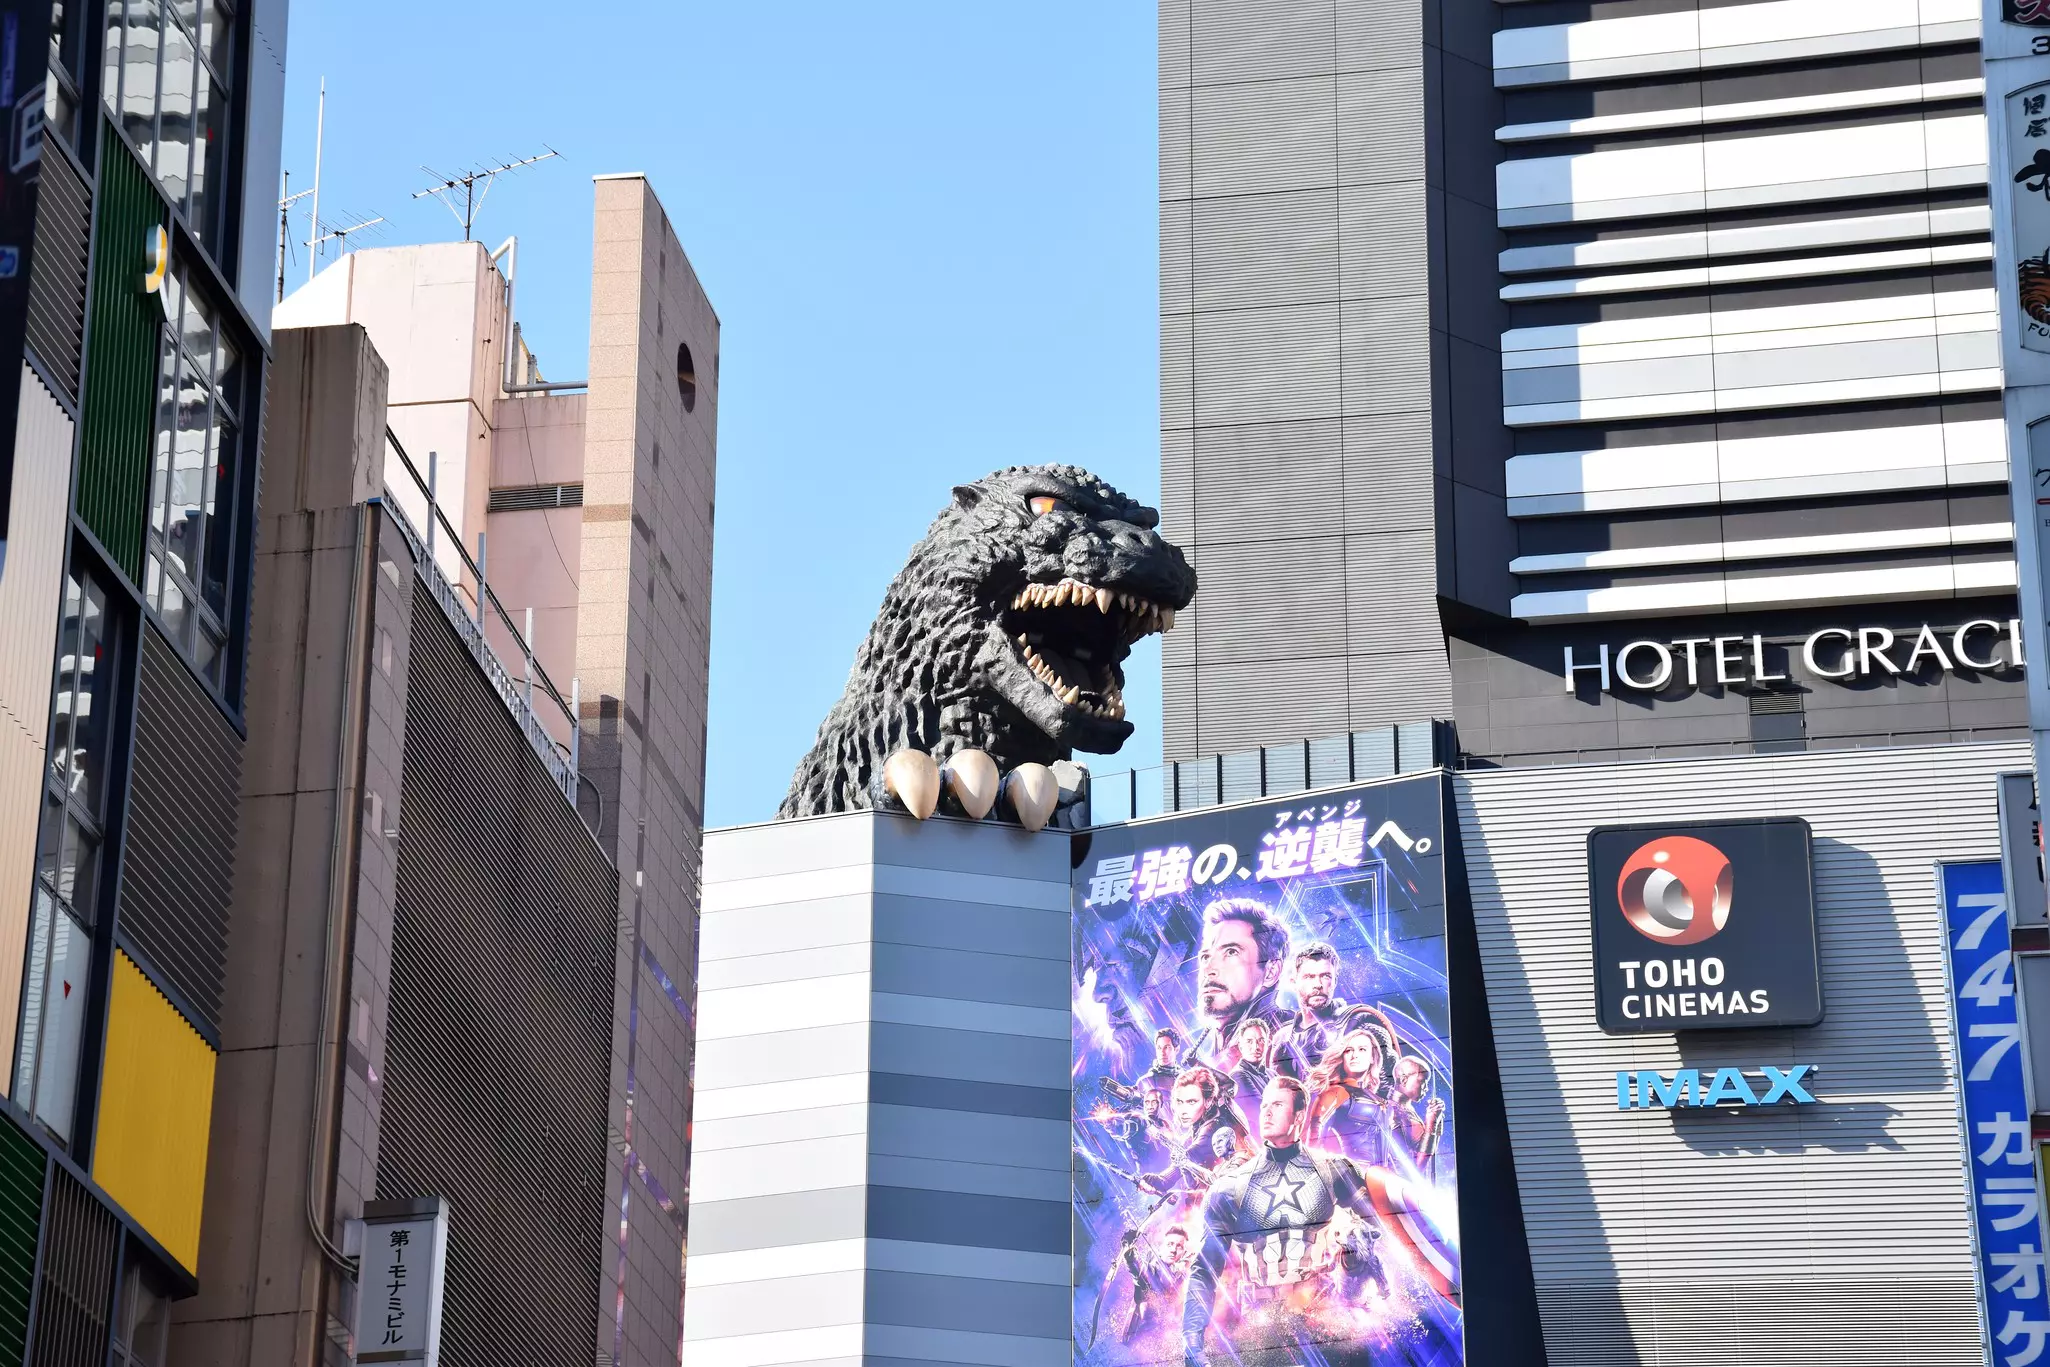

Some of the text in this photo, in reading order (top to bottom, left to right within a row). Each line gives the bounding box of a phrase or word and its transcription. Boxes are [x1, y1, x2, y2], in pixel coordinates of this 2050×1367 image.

[1564, 634, 1787, 694] HOTEL
[1275, 799, 1362, 829] アベンジ
[1619, 957, 1725, 989] TOHO
[1621, 990, 1770, 1019] CINEMAS
[1616, 1065, 1817, 1110] IMAX
[382, 1229, 411, 1345] 第1モナミビル
